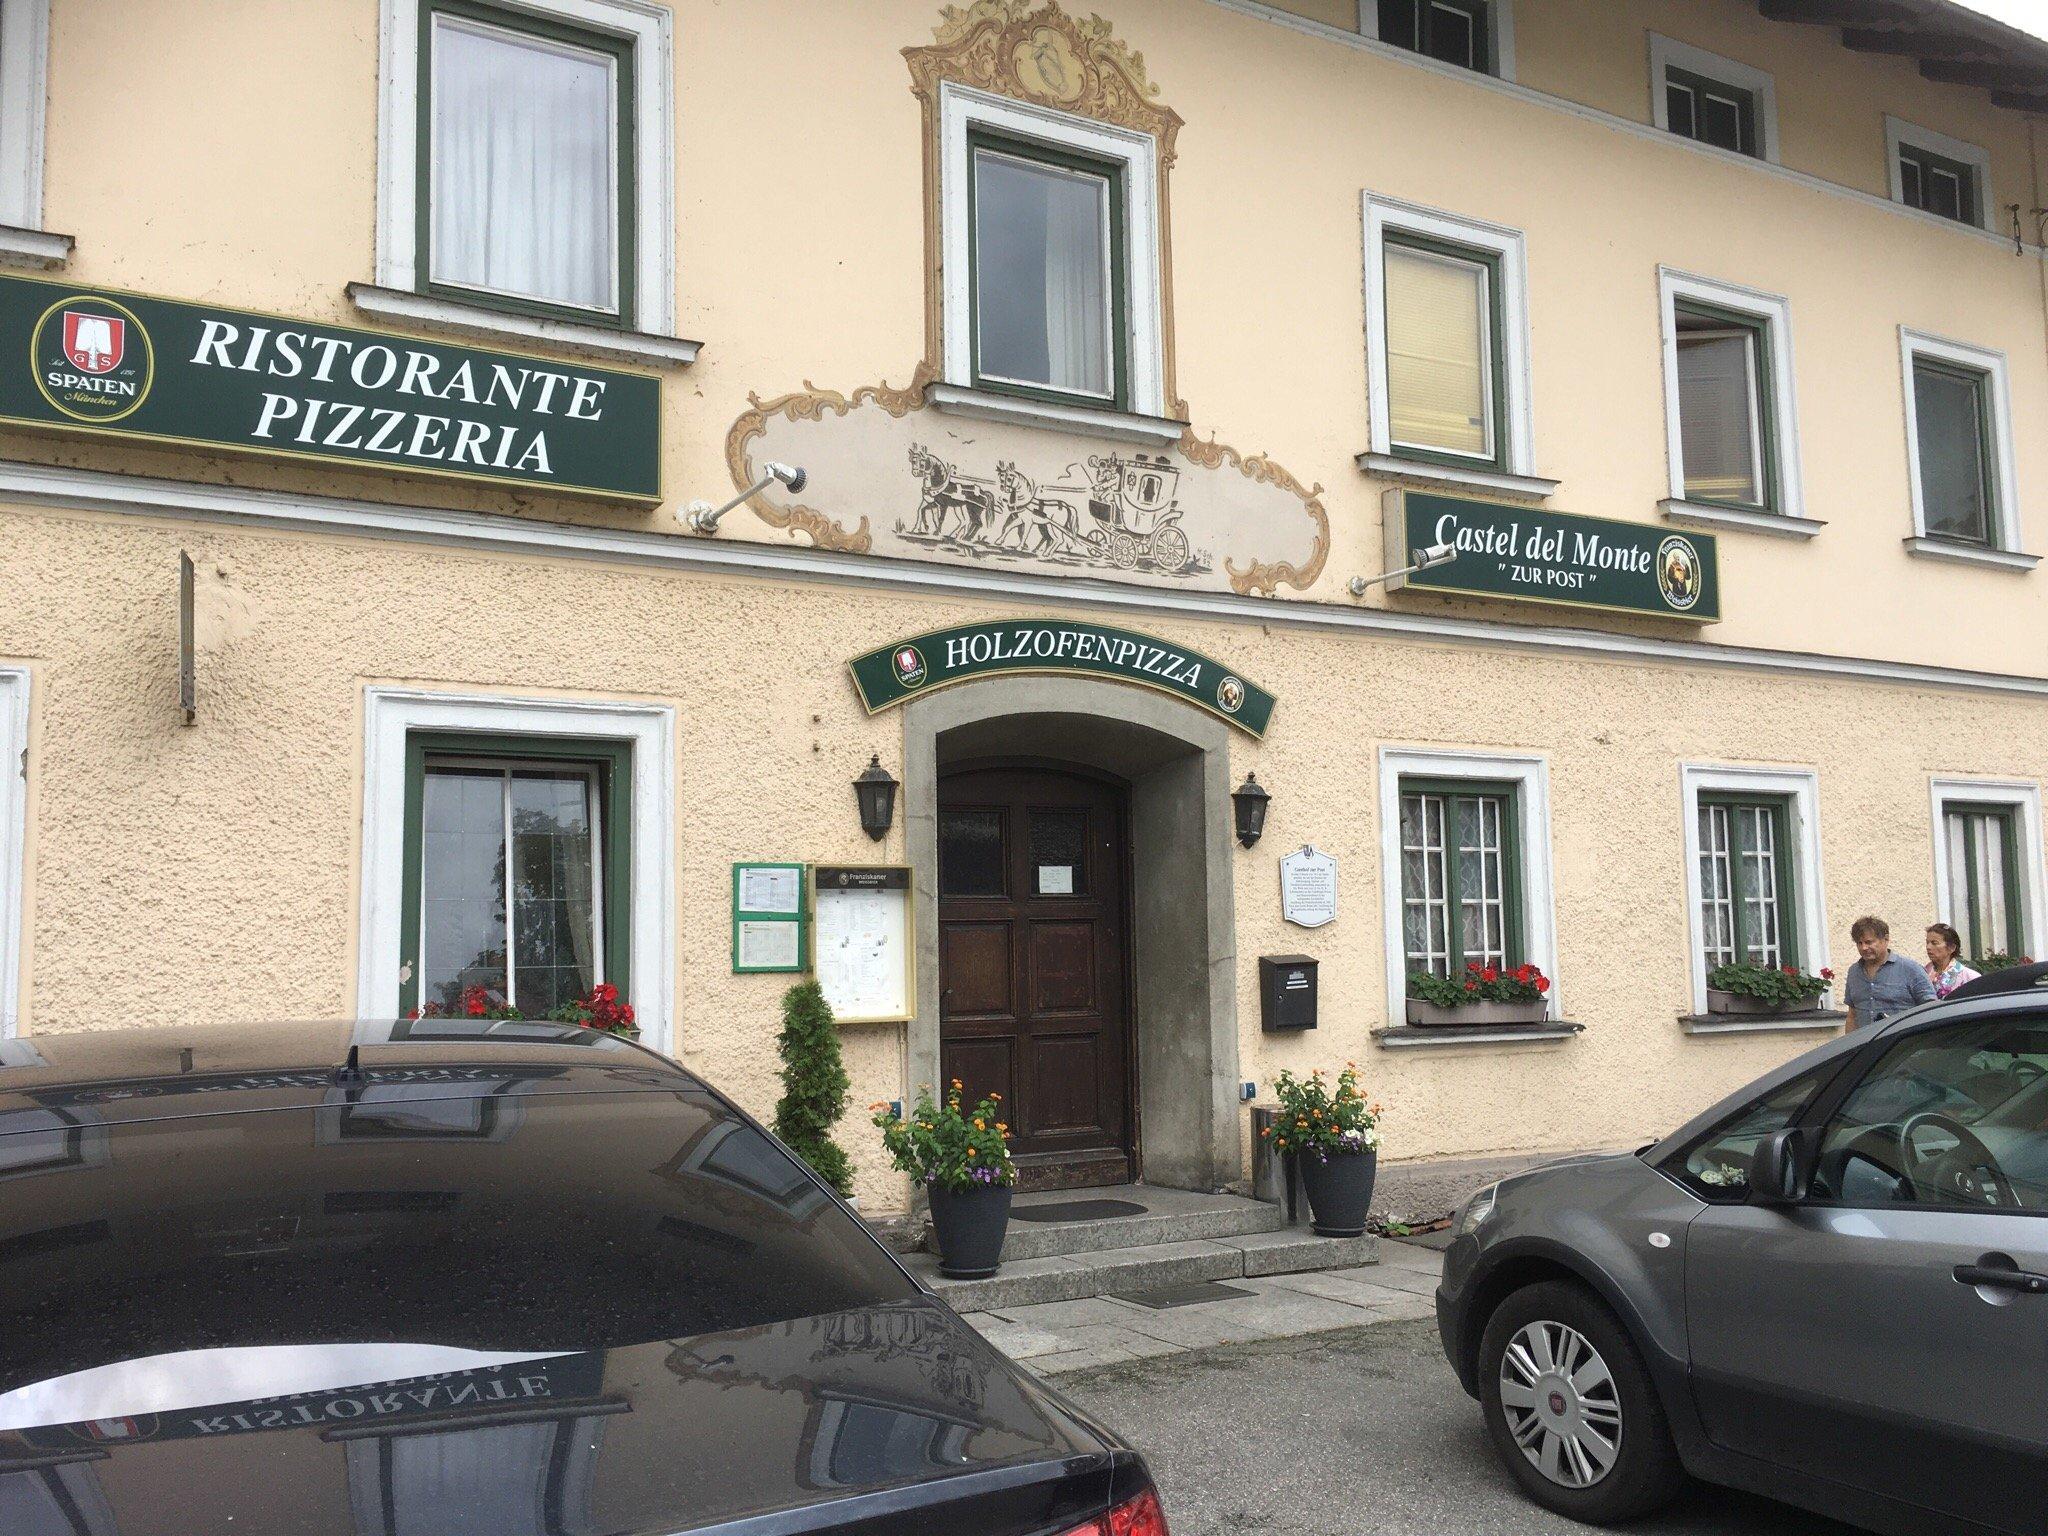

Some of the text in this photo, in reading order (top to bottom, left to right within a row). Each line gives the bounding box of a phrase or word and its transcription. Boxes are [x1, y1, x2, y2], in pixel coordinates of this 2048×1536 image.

[48, 372, 136, 396] SPATEN
[64, 391, 118, 406] München
[189, 318, 607, 422] RISTORANTE
[250, 392, 555, 475] PIZZERIA
[1435, 514, 1652, 574] Castel del Monte
[901, 667, 924, 681] SPATEN
[945, 630, 1204, 689] HOLZOFENPIZZA
